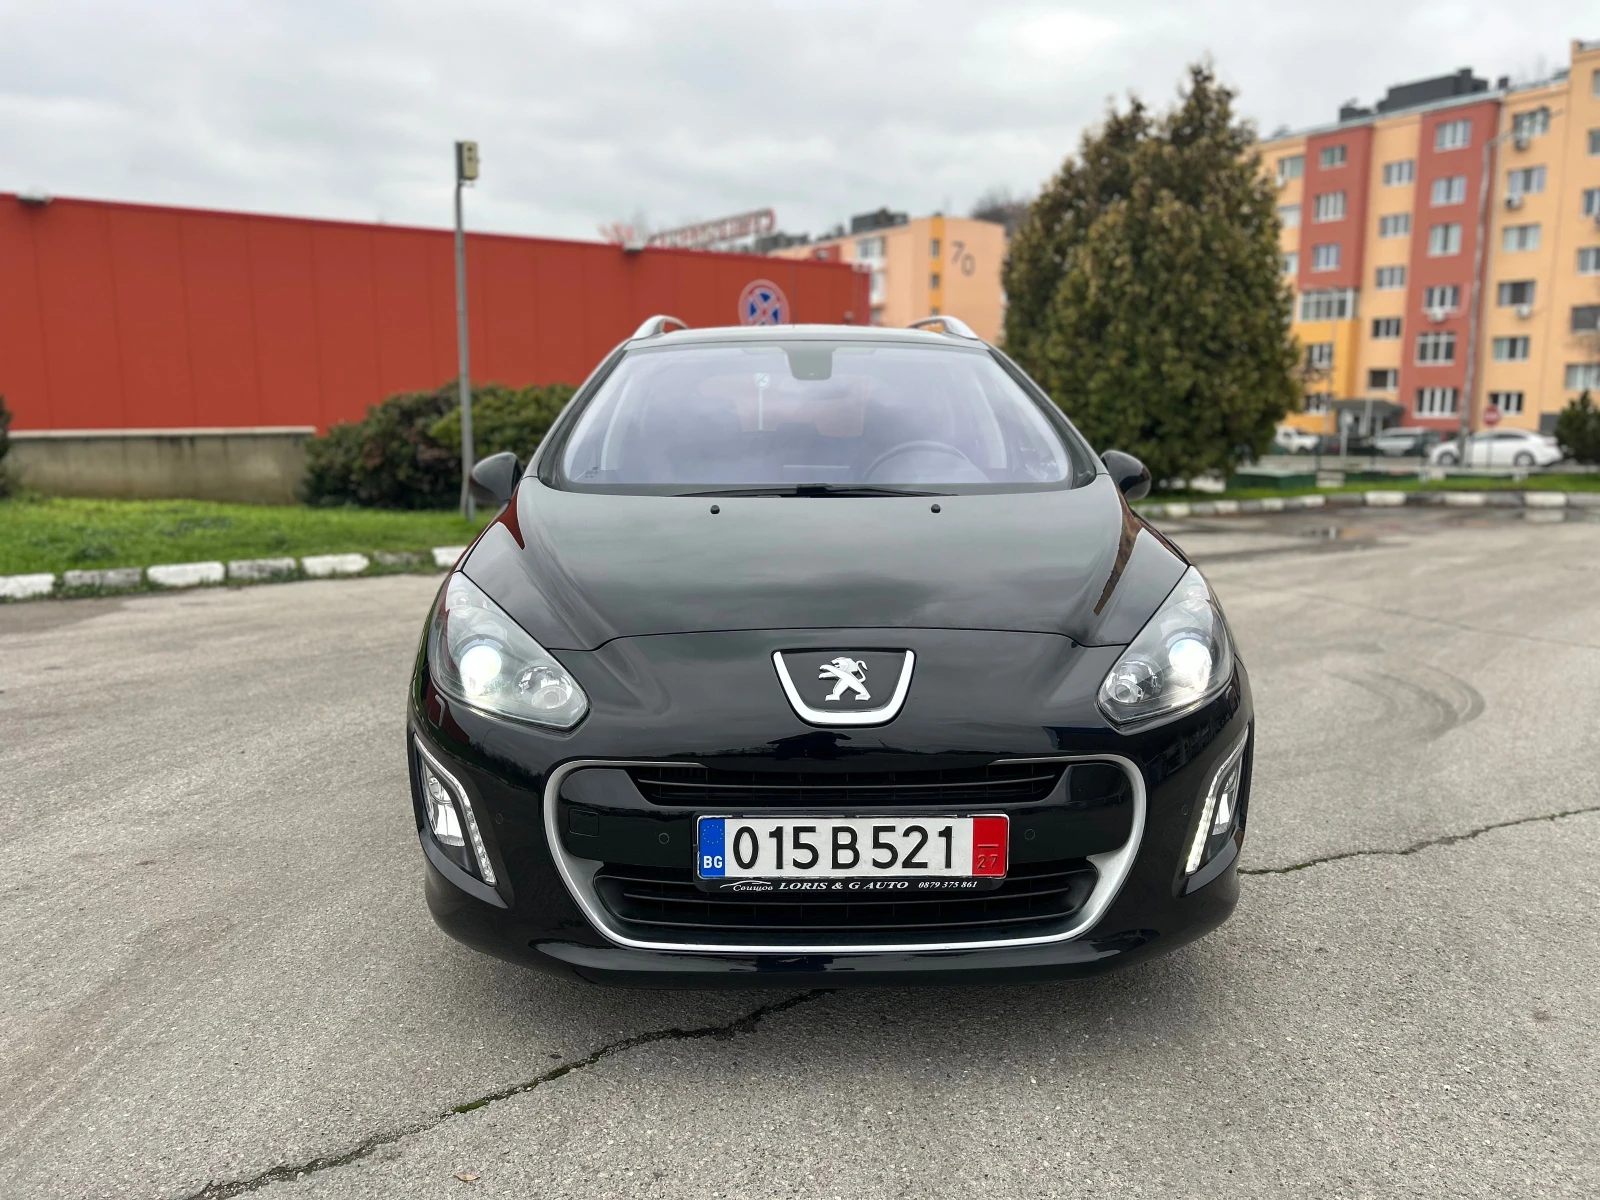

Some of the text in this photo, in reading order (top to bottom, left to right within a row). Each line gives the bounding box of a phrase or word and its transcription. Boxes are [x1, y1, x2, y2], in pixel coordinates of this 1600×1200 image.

[703, 855, 723, 868] BG
[977, 854, 998, 869] 27
[778, 881, 909, 890] LORIS & G AUTO
[918, 880, 978, 889] 0879 375 861
